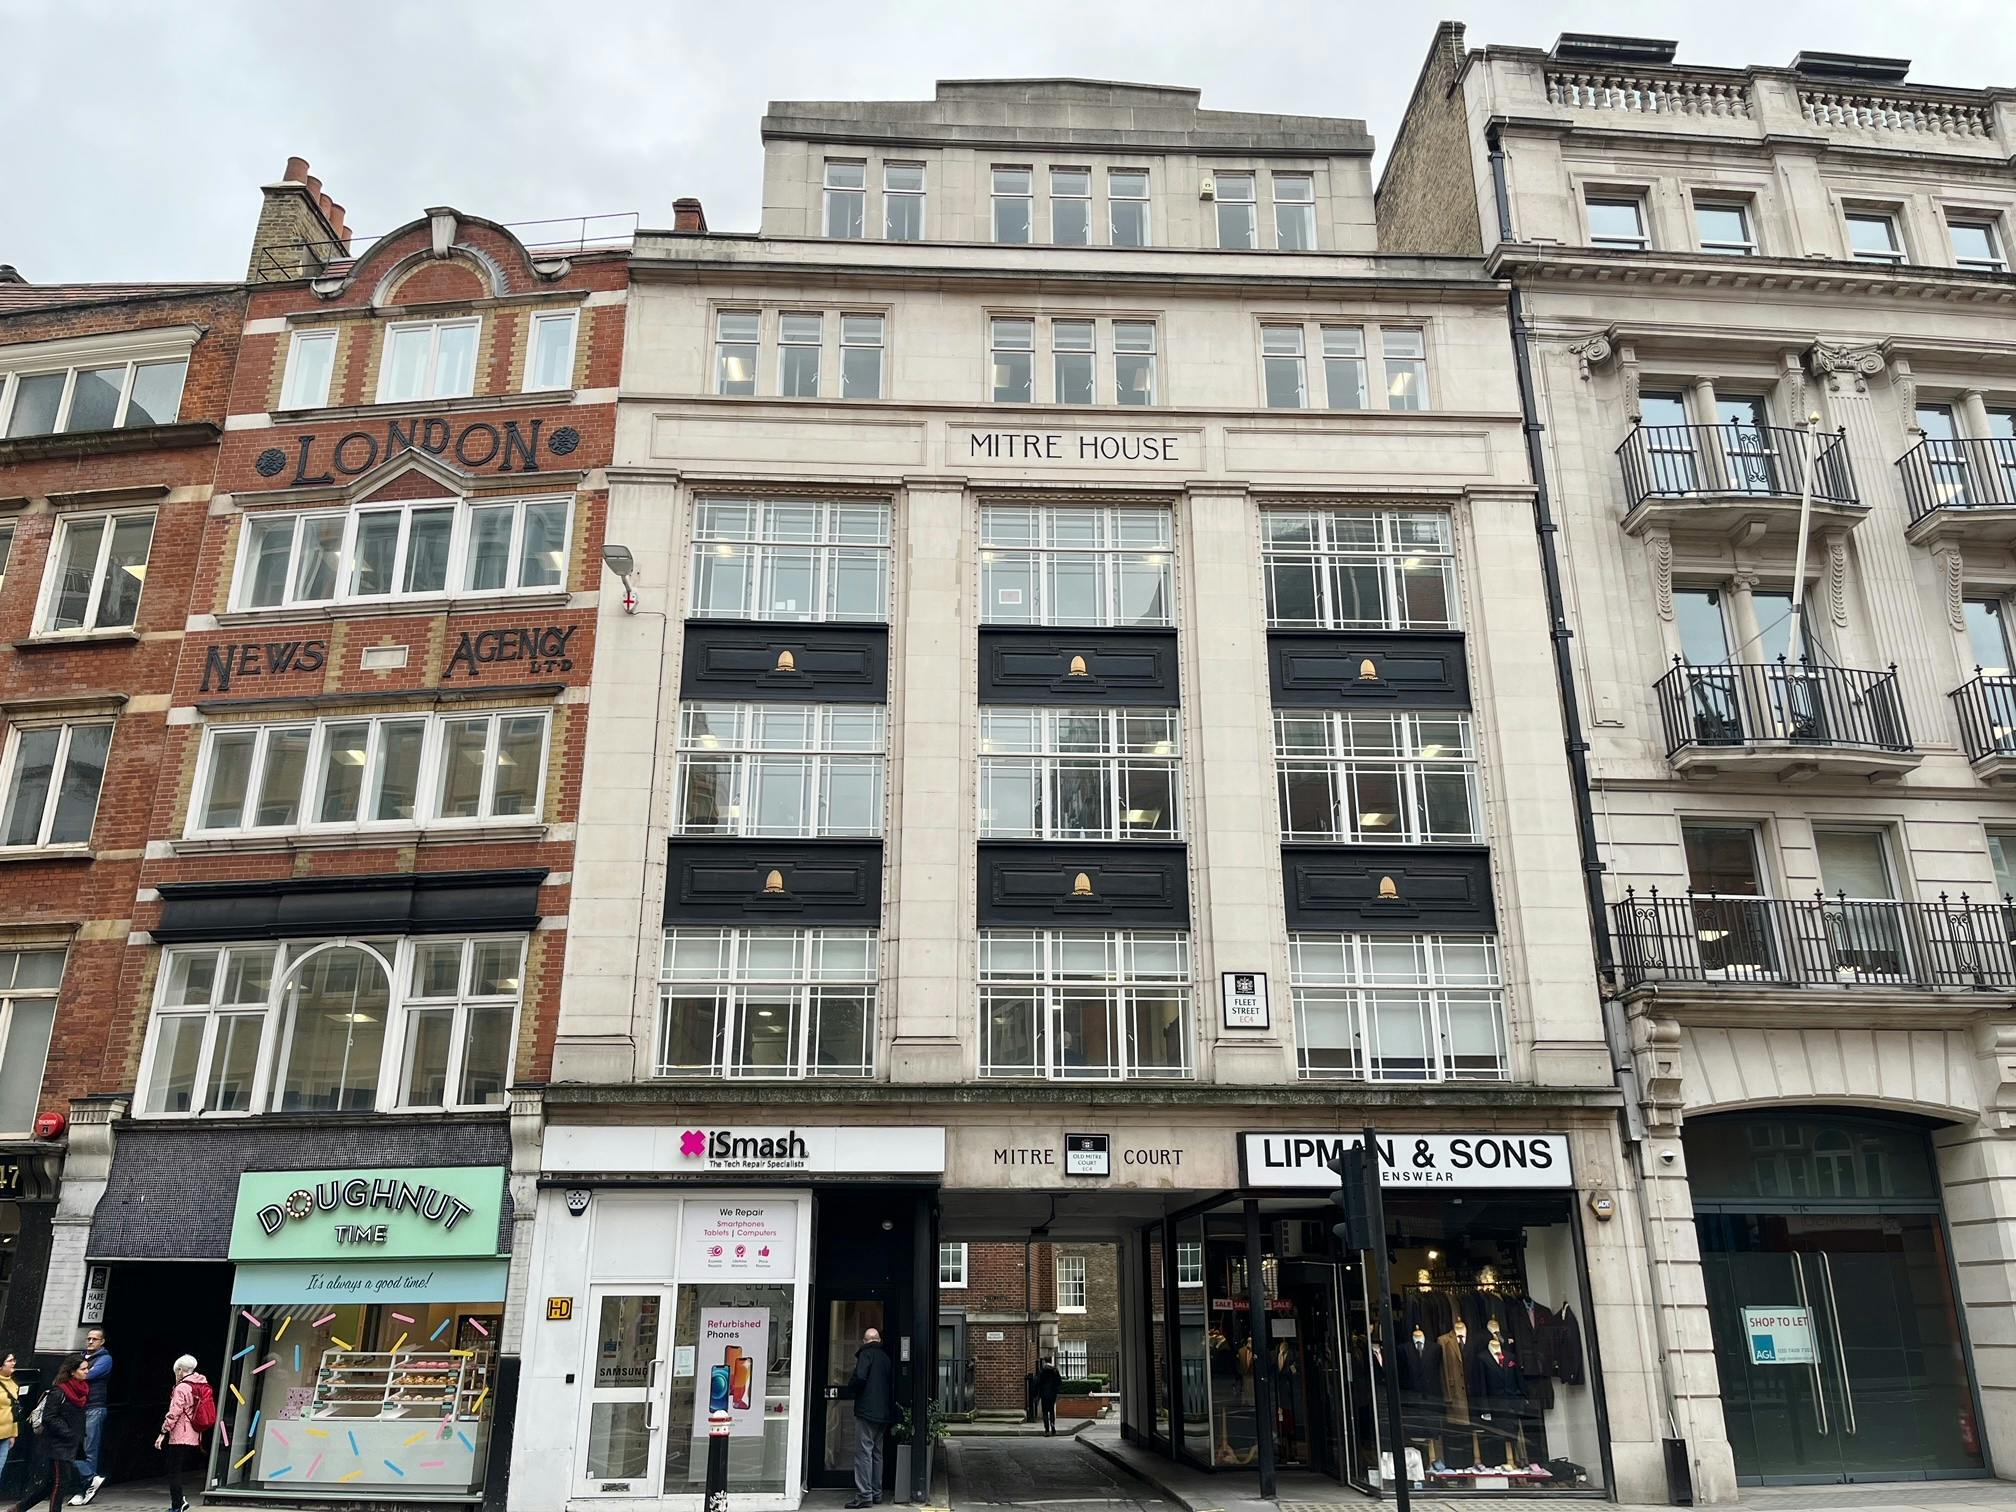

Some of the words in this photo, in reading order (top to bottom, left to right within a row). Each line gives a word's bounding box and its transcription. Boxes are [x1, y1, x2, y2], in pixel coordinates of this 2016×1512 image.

[291, 418, 543, 486] LONDON
[971, 433, 1062, 459] MITRE
[1080, 436, 1179, 461] HOUSE
[200, 641, 326, 691] NEWS
[443, 626, 577, 678] AGENCY
[708, 1130, 806, 1158] iSmash
[994, 1149, 1055, 1164] MITRE
[1123, 1149, 1183, 1165] COURT
[1412, 1139, 1435, 1168] &
[1450, 1139, 1551, 1169] SONS
[710, 1160, 722, 1168] The
[724, 1160, 741, 1168] Tech
[743, 1160, 766, 1168] Repair
[767, 1160, 805, 1169] Specialists
[1383, 1172, 1453, 1182] ENSWEAR
[256, 1178, 472, 1237] DOUGHNUT
[720, 1208, 733, 1216] We
[735, 1208, 763, 1217] Repair
[717, 1220, 764, 1228] Smartphones
[335, 1225, 388, 1243] TIME
[736, 1229, 777, 1237] Computers
[305, 1274, 324, 1290] It's
[326, 1275, 362, 1293] always
[365, 1281, 373, 1289] a
[375, 1276, 401, 1294] good
[403, 1272, 433, 1289] time!
[88, 1292, 105, 1301] HARE
[86, 1302, 103, 1310] PLACE
[707, 1320, 761, 1328] Refurbished
[1750, 1317, 1775, 1327] SHOP
[1777, 1317, 1790, 1327] TO
[1793, 1316, 1808, 1327] LET
[707, 1330, 740, 1338] Phones
[1757, 1350, 1775, 1359] AGL
[600, 1367, 649, 1377] SAMSUNG
